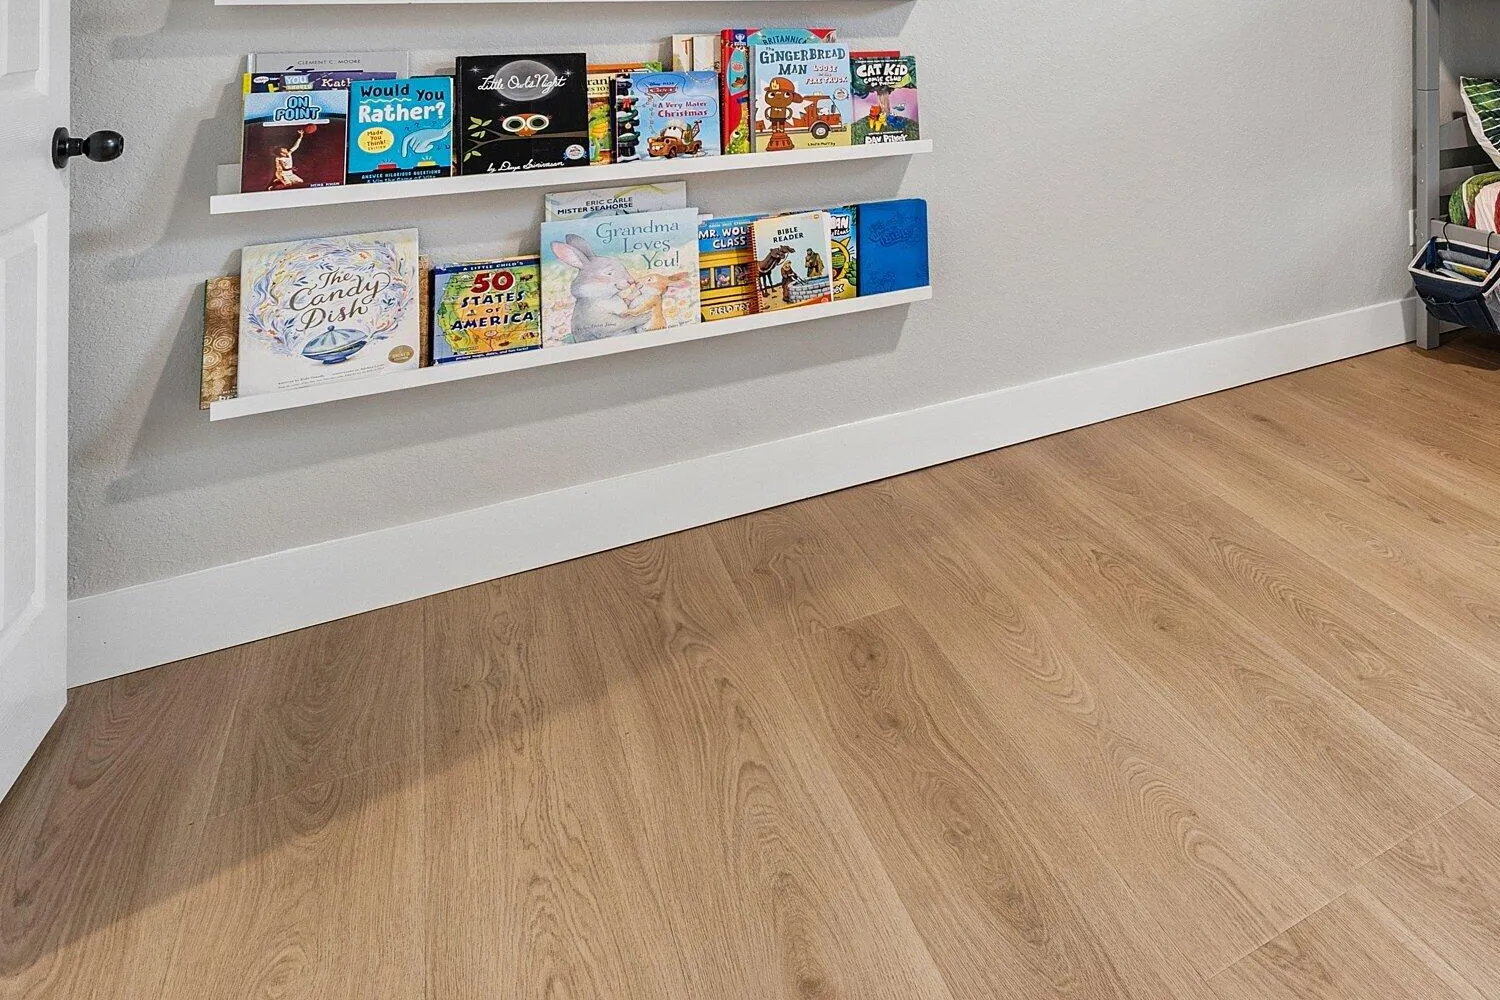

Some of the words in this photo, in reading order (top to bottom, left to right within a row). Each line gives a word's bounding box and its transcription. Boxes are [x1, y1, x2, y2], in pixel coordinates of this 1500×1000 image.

[778, 64, 808, 75] MAN
[856, 63, 882, 78] CAT
[285, 74, 309, 84] YOU
[478, 74, 505, 90] Little
[533, 73, 567, 95] Night
[360, 83, 410, 97] Would
[287, 95, 310, 109] ON
[275, 106, 321, 122] POINT
[358, 101, 446, 124] Rather?
[658, 109, 708, 117] Christmas
[557, 206, 588, 215] MISTER
[590, 201, 633, 211] SEAHORSE
[585, 199, 605, 207] ERIC
[606, 196, 633, 204] CARLE
[595, 219, 680, 244] Grandma
[698, 229, 719, 240] MR.
[721, 226, 750, 238] WOL
[773, 233, 804, 243] READER
[777, 226, 798, 236] BIBLE
[623, 237, 671, 254] Loves
[712, 236, 746, 249] CLASS
[641, 250, 680, 270] You!
[318, 269, 354, 289] The
[469, 269, 516, 294] 50
[288, 272, 391, 312] Candy
[461, 290, 526, 308] STATES
[296, 299, 369, 332] Dish
[451, 311, 535, 331] AMERICA
